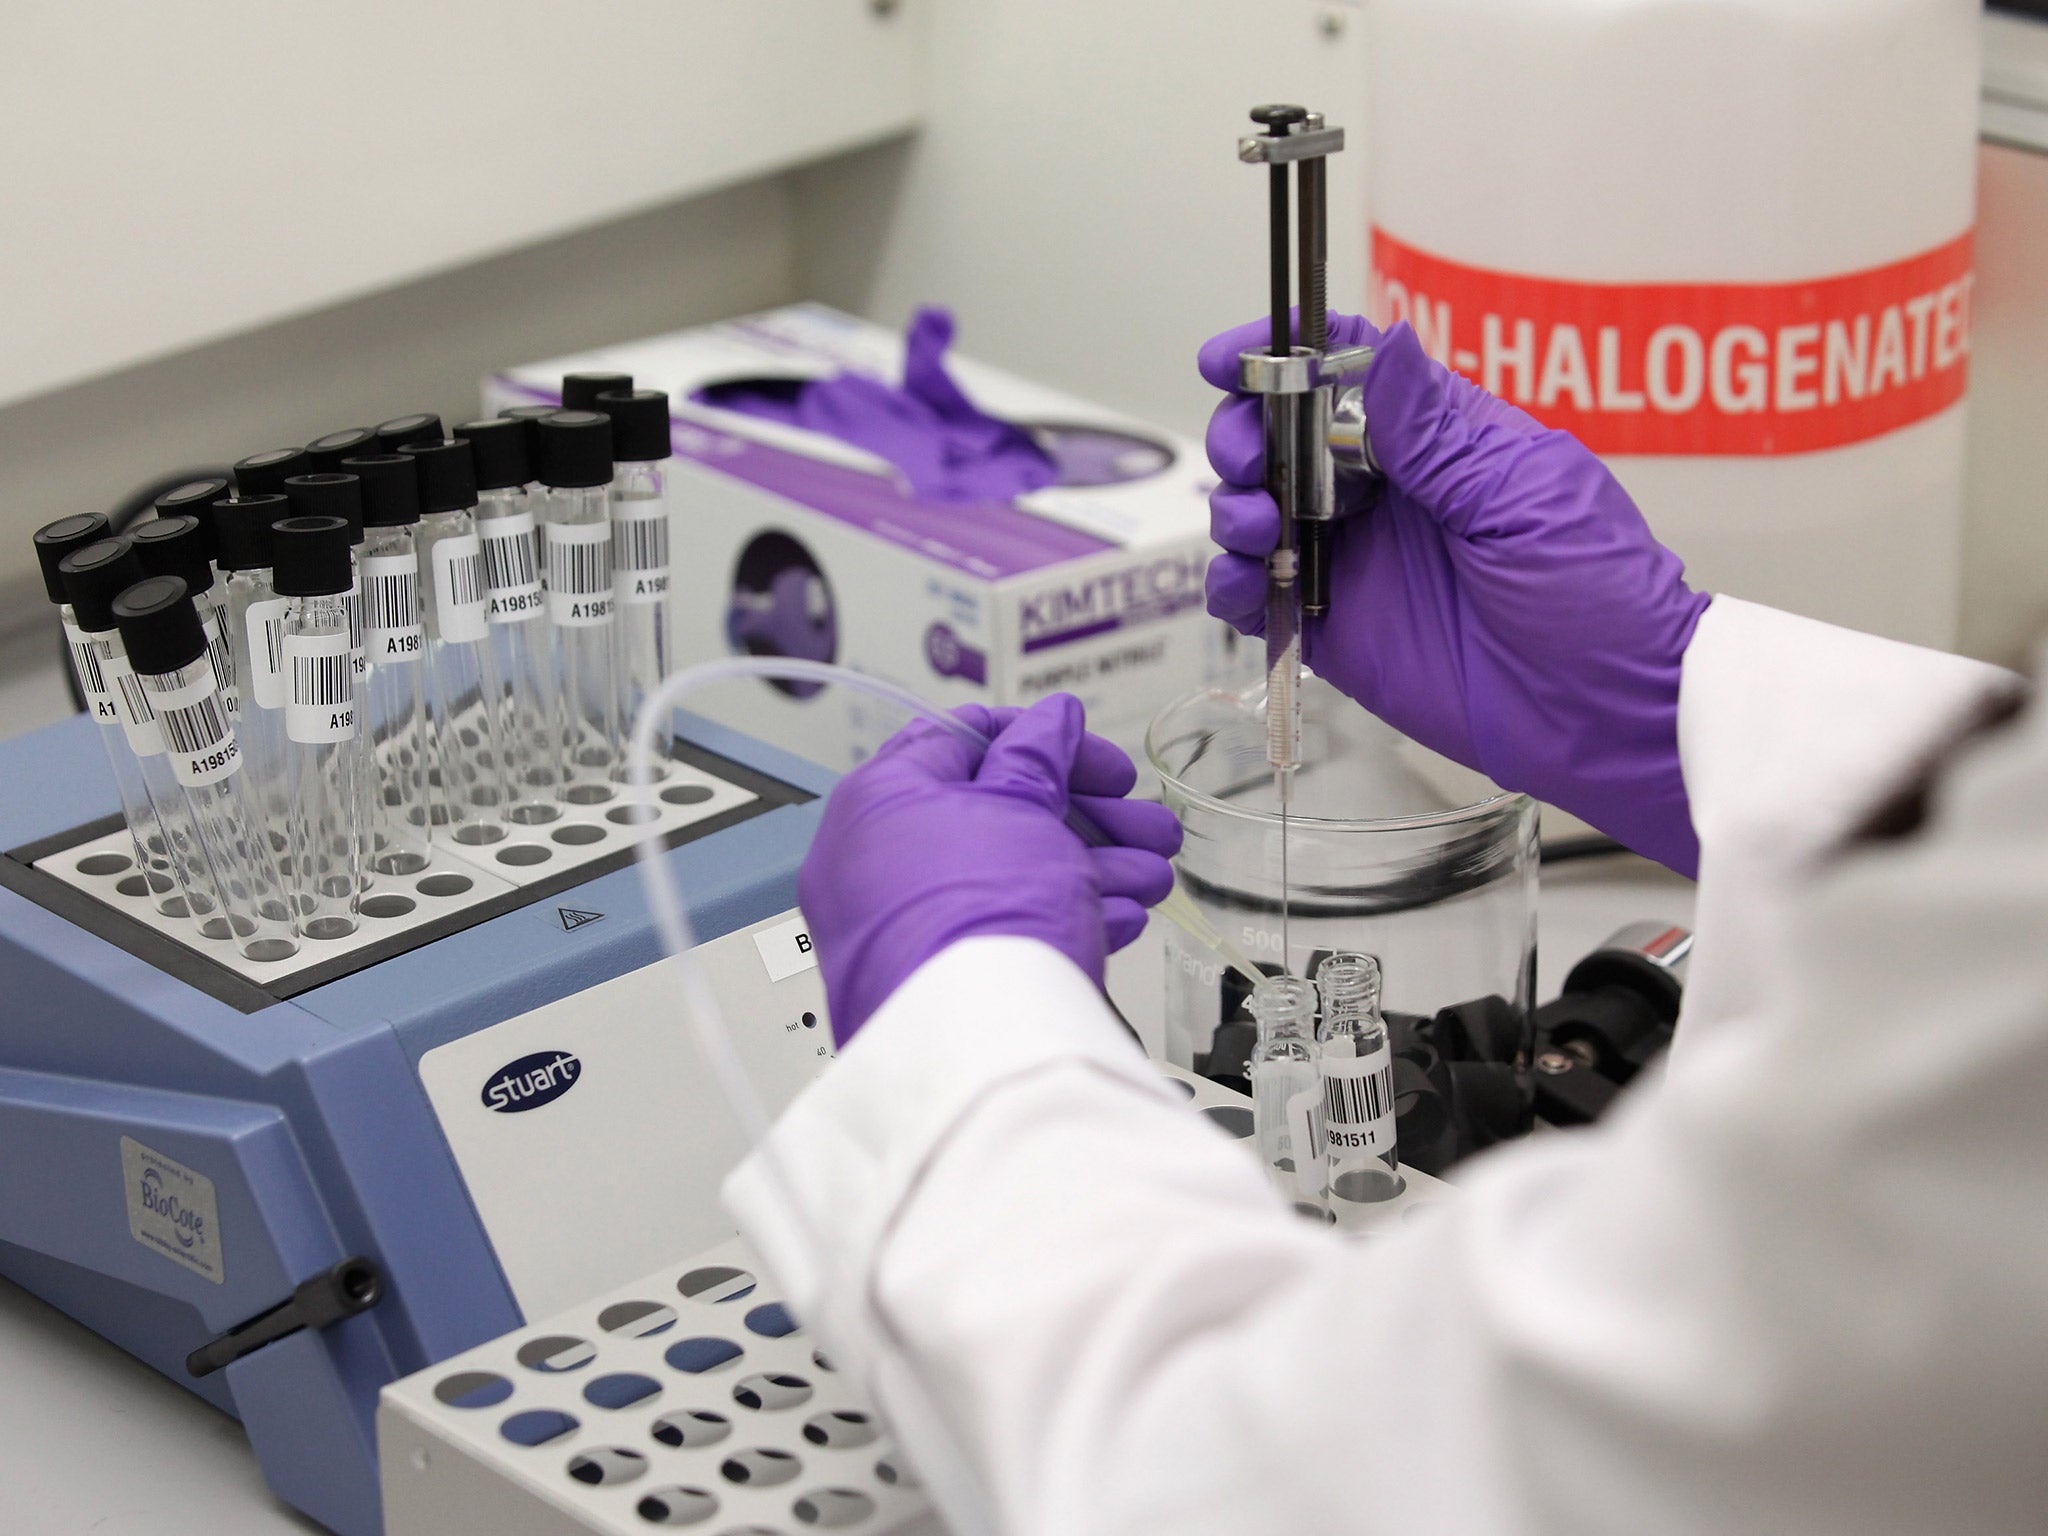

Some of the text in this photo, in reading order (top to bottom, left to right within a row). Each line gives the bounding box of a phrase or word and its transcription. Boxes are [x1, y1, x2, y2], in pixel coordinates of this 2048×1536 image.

[1242, 926, 1284, 951] 500
[786, 1022, 800, 1032] hot
[488, 1054, 578, 1110] stuart
[140, 1179, 204, 1236] BioCote
